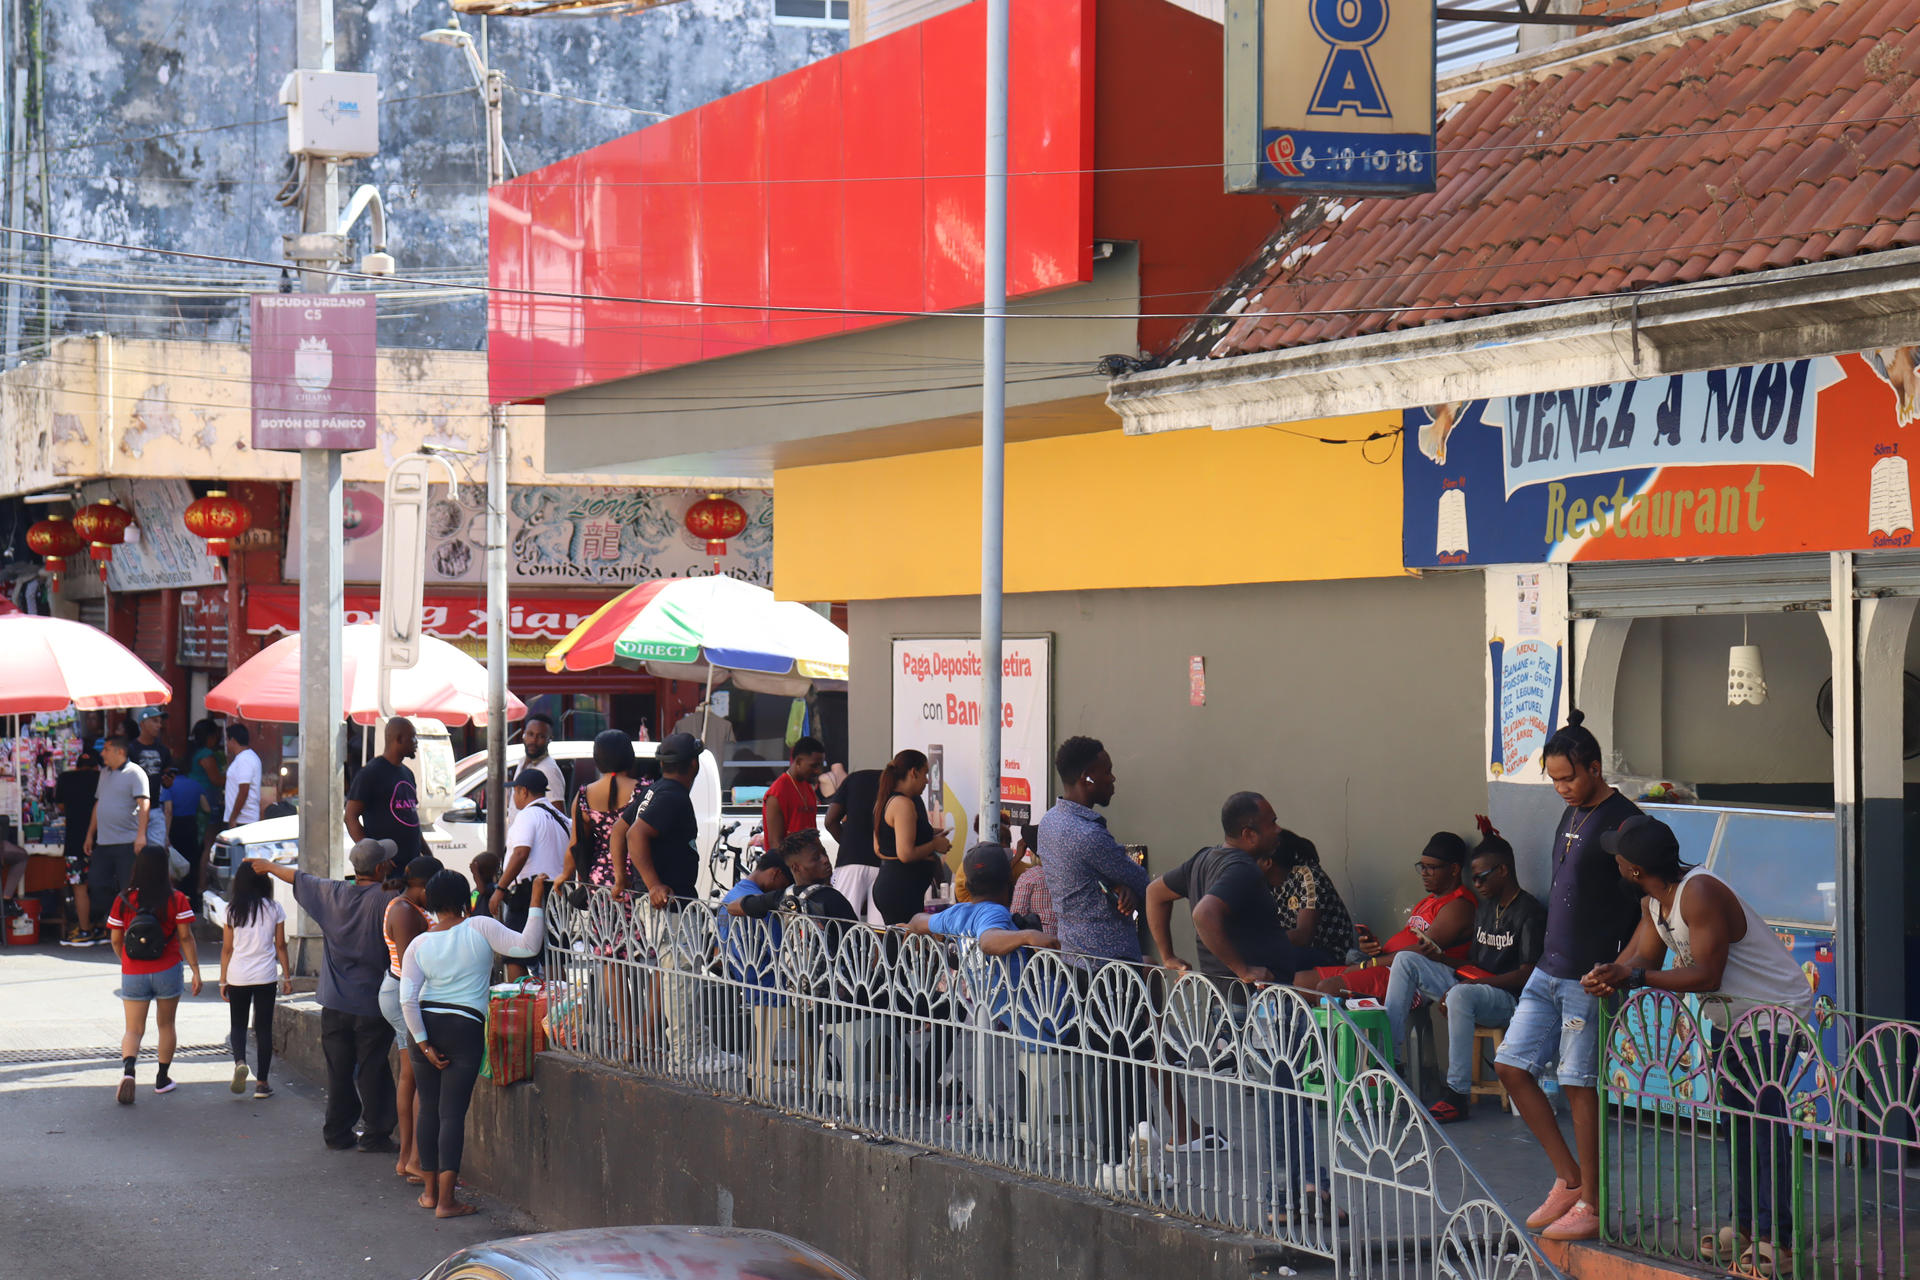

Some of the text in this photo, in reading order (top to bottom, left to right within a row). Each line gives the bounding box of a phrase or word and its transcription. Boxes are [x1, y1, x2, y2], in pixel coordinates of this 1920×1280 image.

[261, 297, 366, 307] ESCUDO URBANO
[304, 309, 322, 320] C5
[1700, 358, 1811, 445] MOI
[261, 417, 366, 428] BOTÓN DE PÁNICO
[1544, 466, 1765, 544] Restaurant
[583, 521, 622, 560] 龍
[516, 561, 592, 578] Comida
[599, 561, 663, 583] rápida
[624, 642, 689, 657] DIRECT
[1517, 644, 1538, 656] MENU
[1001, 651, 1032, 677] etira
[1503, 672, 1529, 692] POISSON
[1516, 686, 1544, 699] LEGUMES
[922, 702, 943, 720] con
[1503, 701, 1542, 724] JUS NATUREL
[1004, 759, 1020, 770] Retira
